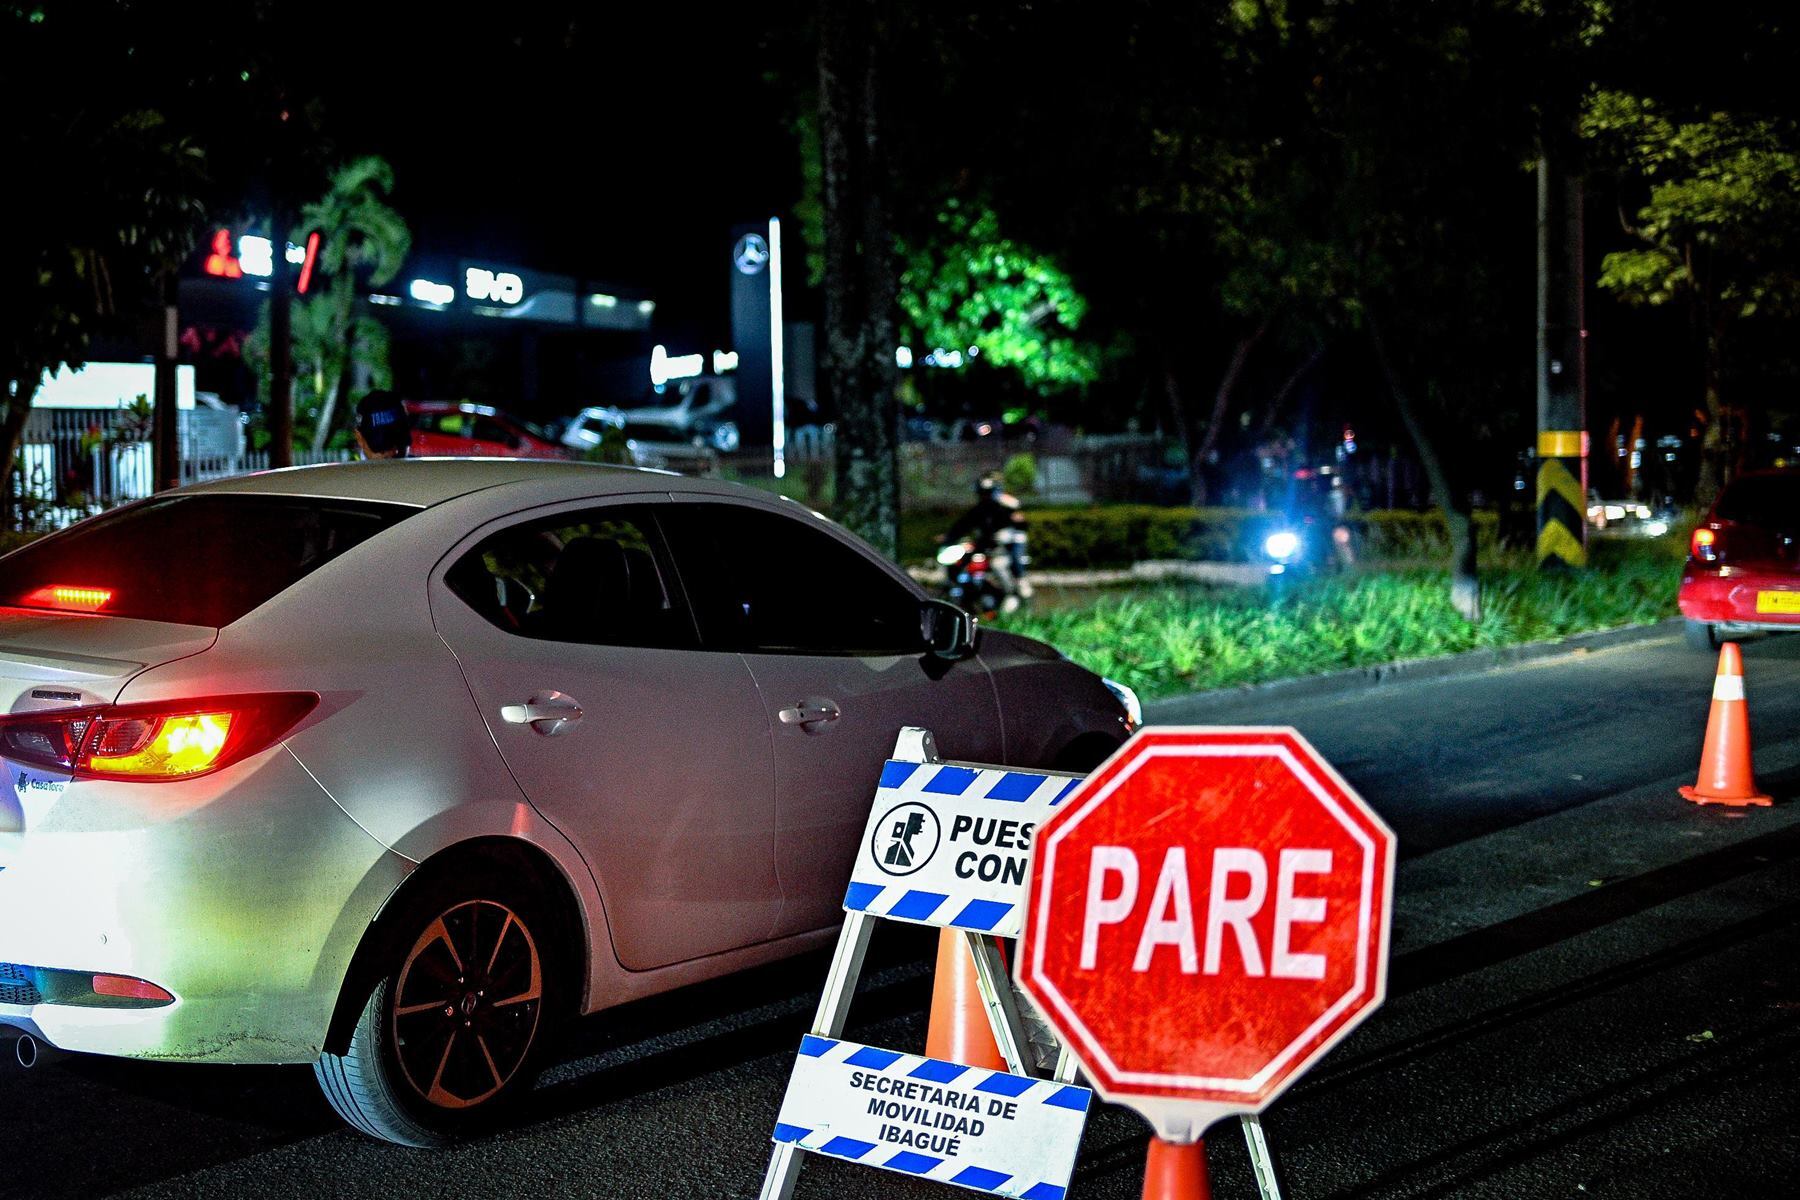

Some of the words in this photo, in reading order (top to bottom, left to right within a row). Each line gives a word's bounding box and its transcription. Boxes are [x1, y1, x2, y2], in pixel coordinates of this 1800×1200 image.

[954, 850, 1028, 886] CON
[1079, 845, 1333, 980] PARE
[849, 1071, 980, 1114] SECRETARIA
[987, 1098, 1018, 1121] DE
[867, 1097, 985, 1137] MOVILIDAD
[878, 1123, 961, 1157] IBAGUÉ
